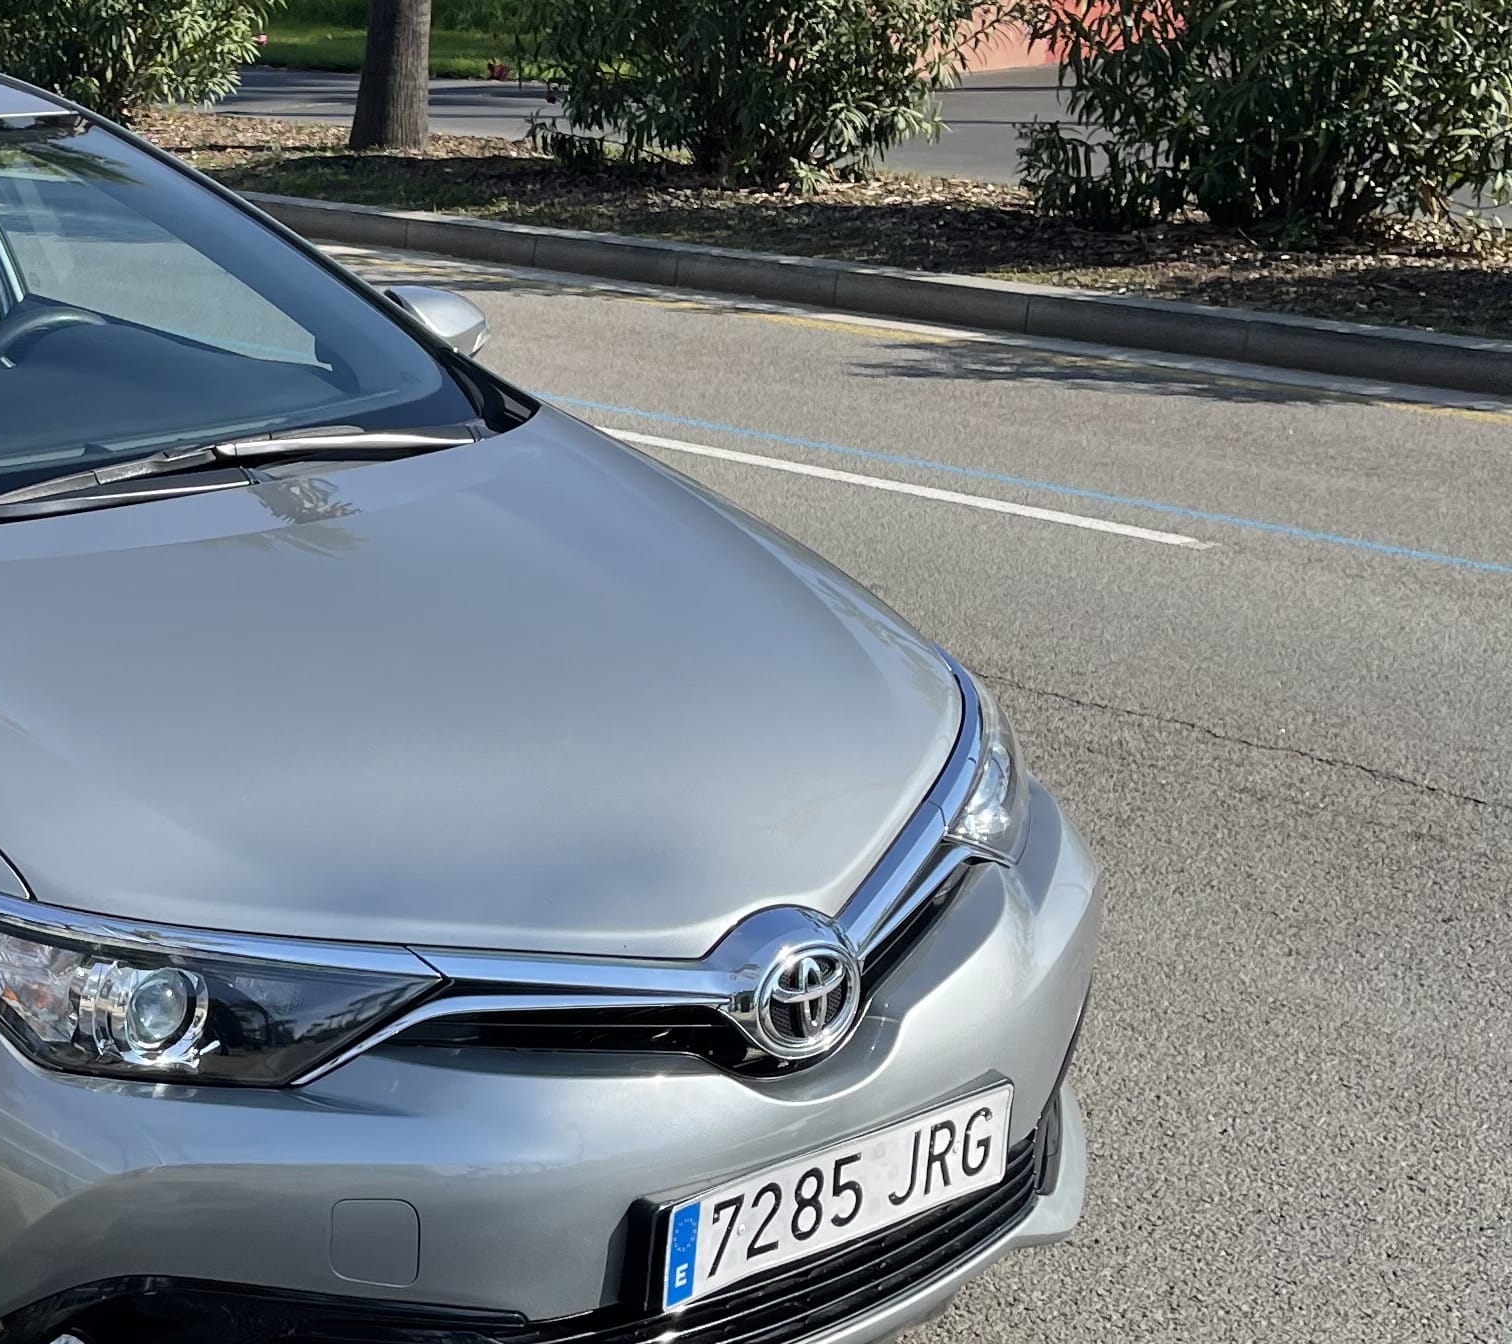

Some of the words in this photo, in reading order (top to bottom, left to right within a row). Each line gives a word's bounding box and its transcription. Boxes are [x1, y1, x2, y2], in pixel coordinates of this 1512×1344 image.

[674, 1263, 689, 1288] E
[706, 1151, 863, 1279] 7285
[888, 1106, 993, 1207] JRG
